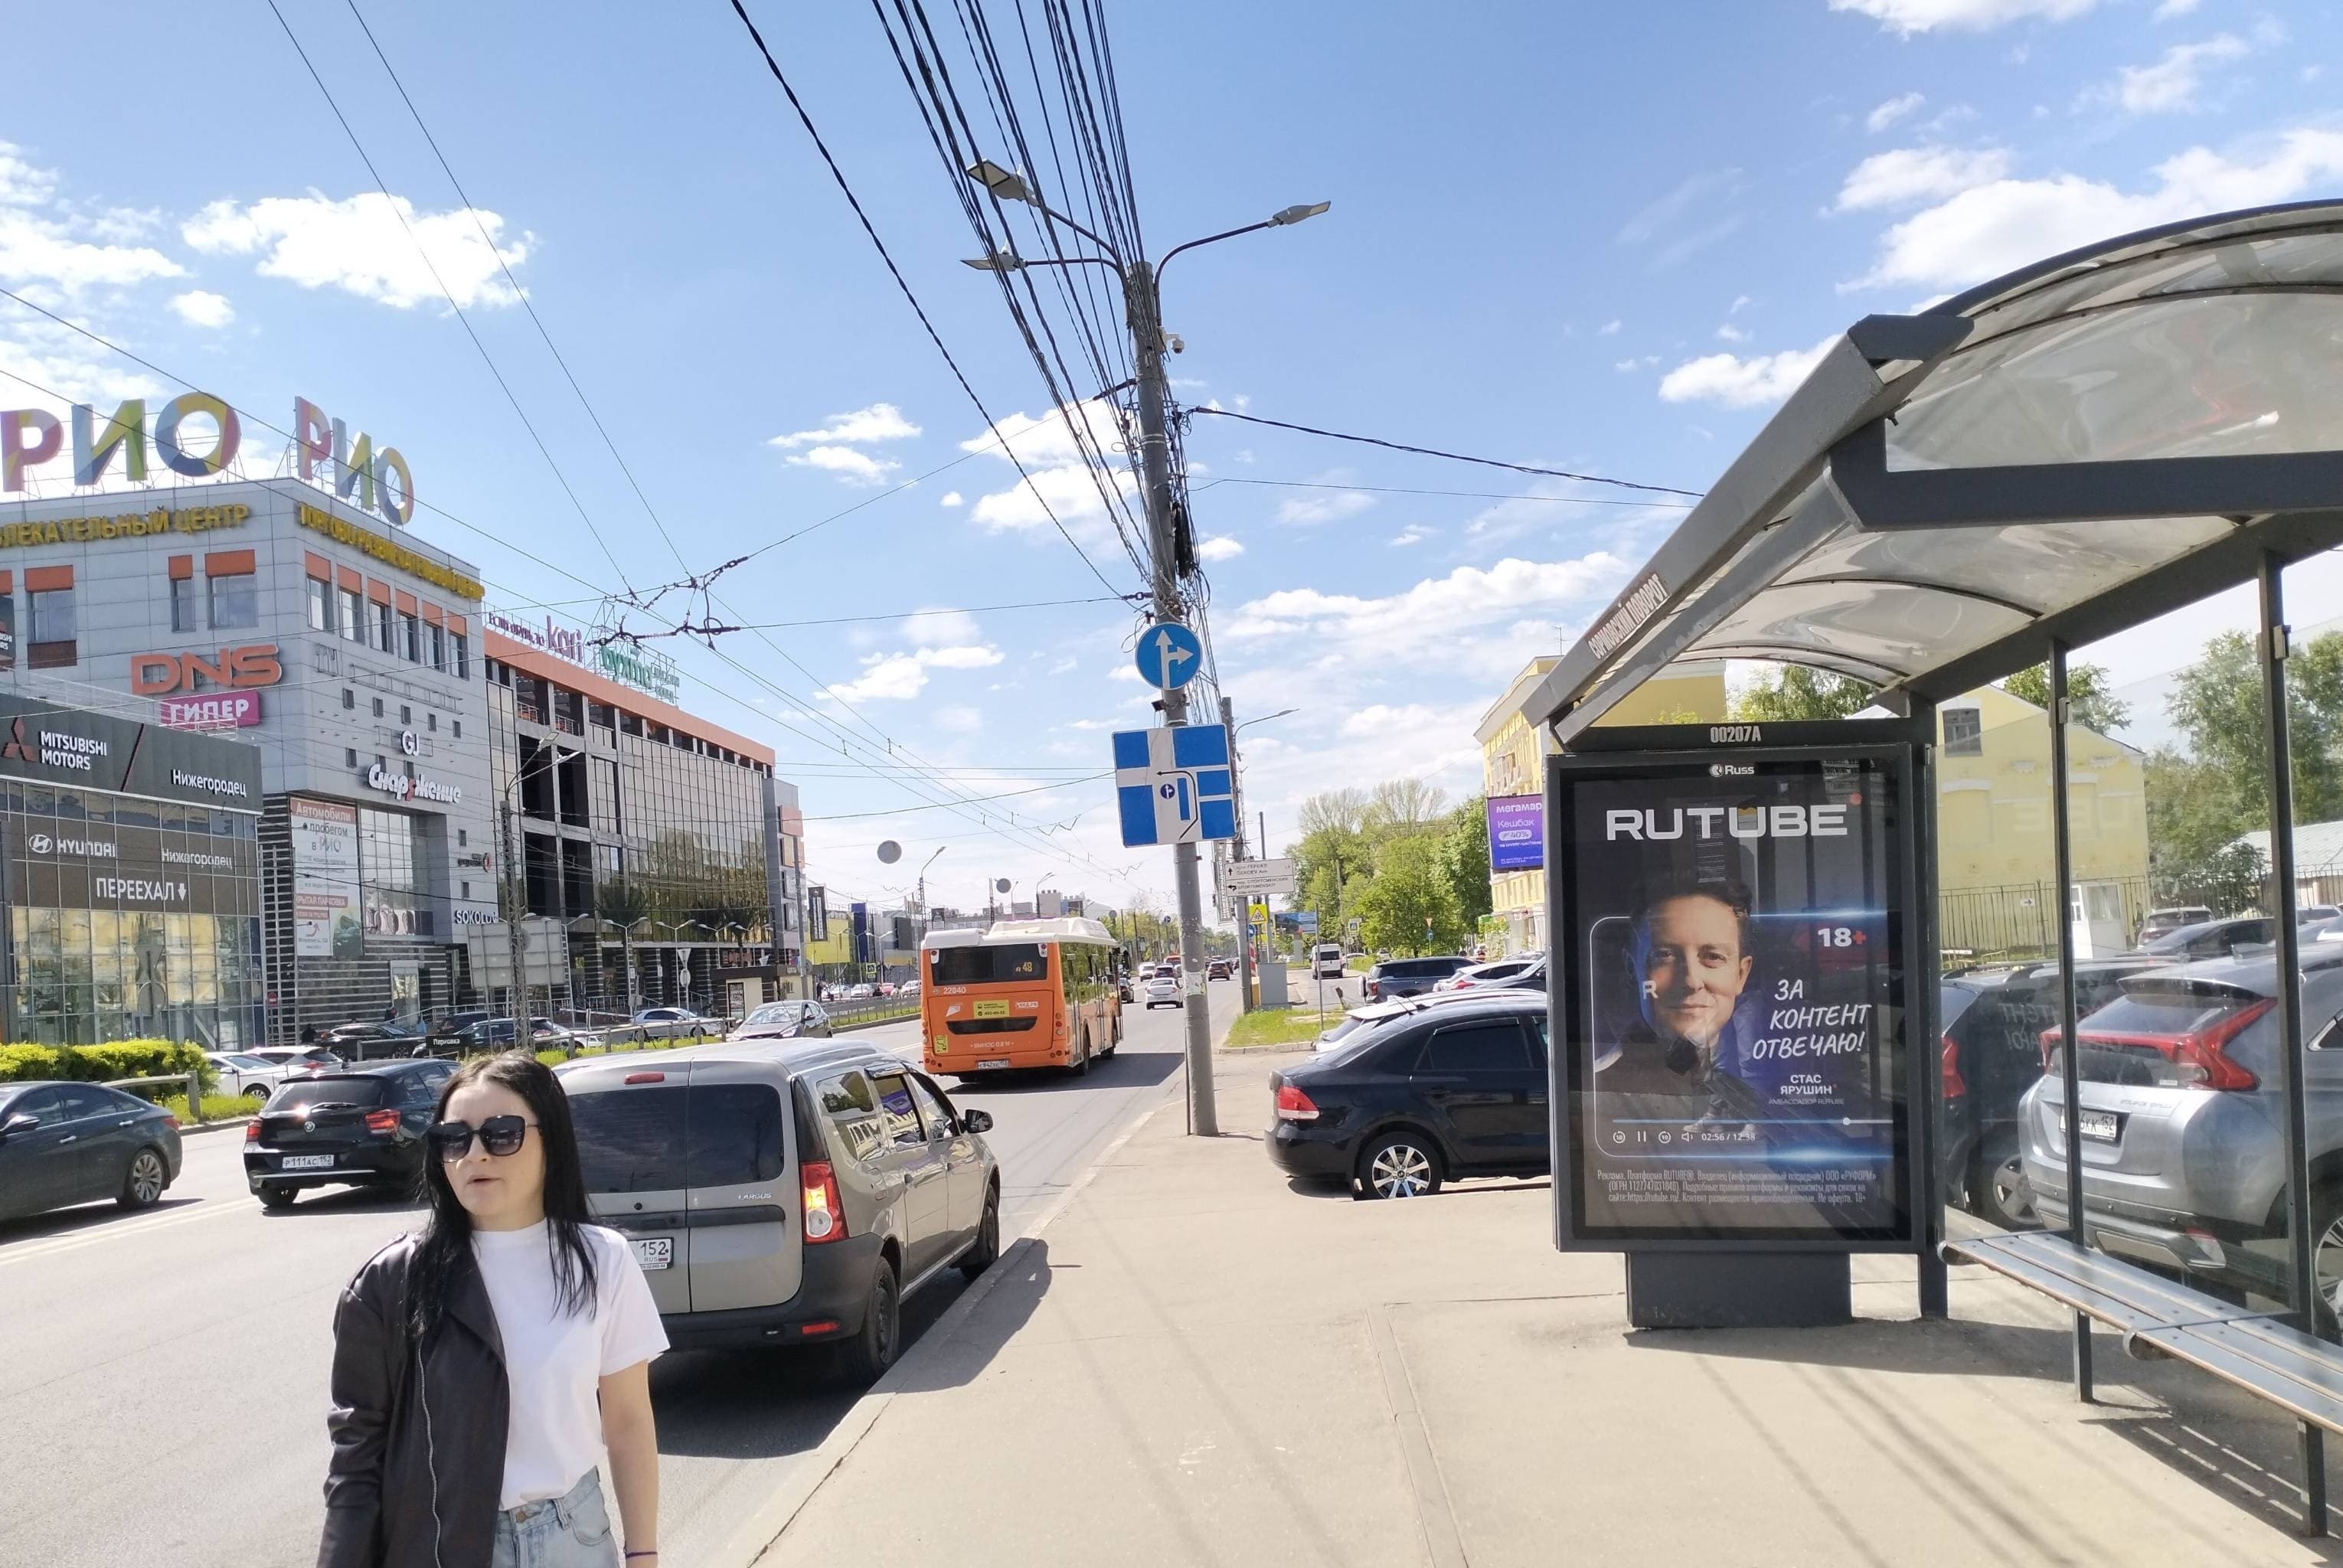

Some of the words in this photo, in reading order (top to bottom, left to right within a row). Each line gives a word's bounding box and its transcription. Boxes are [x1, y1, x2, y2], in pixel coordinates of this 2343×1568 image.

[0, 392, 240, 492] РИО
[295, 396, 414, 525] РИО
[0, 505, 170, 547] ЛЕКАТЕЛЬНЫЙ
[175, 503, 250, 534] ЦЕНТР
[1588, 601, 1636, 659] СОРМОВСКИЙ
[1626, 573, 1668, 624] ПОВОРОТ
[546, 615, 582, 662] kari
[130, 645, 283, 694] DNS
[169, 699, 250, 722] ГИПЕР
[41, 730, 108, 756] MITSUBISHI
[401, 730, 420, 756] GJ
[41, 749, 90, 770] MOTORS
[1724, 765, 1755, 775] Russ
[172, 769, 247, 798] Нижегородец
[296, 802, 351, 822] Автомобили
[1495, 802, 1542, 814] мегамар
[309, 822, 348, 838] пробегом
[1606, 804, 1848, 841] RUTUBE
[57, 839, 116, 858] HYUNDAI
[161, 848, 234, 870] Нижегородец
[96, 877, 175, 900] ПЕРЕЕХАЛ
[1818, 927, 1867, 947] 18+
[1774, 978, 1803, 1001] ЗА
[1770, 1004, 1872, 1031] КОНТЕНТ
[1753, 1031, 1865, 1060] ОТВЕЧАЮ!
[1790, 1074, 1822, 1083] СТАС
[1780, 1086, 1832, 1095] ЯРУШИН
[2080, 1113, 2099, 1132] 6КК
[1701, 1133, 1724, 1142] 02:56
[285, 1157, 318, 1167] Р111АС
[1597, 1169, 1626, 1181] Реклама.
[1627, 1169, 1662, 1183] Платформа
[1609, 1181, 1627, 1192] (ОГРН
[640, 1241, 666, 1256] 152
